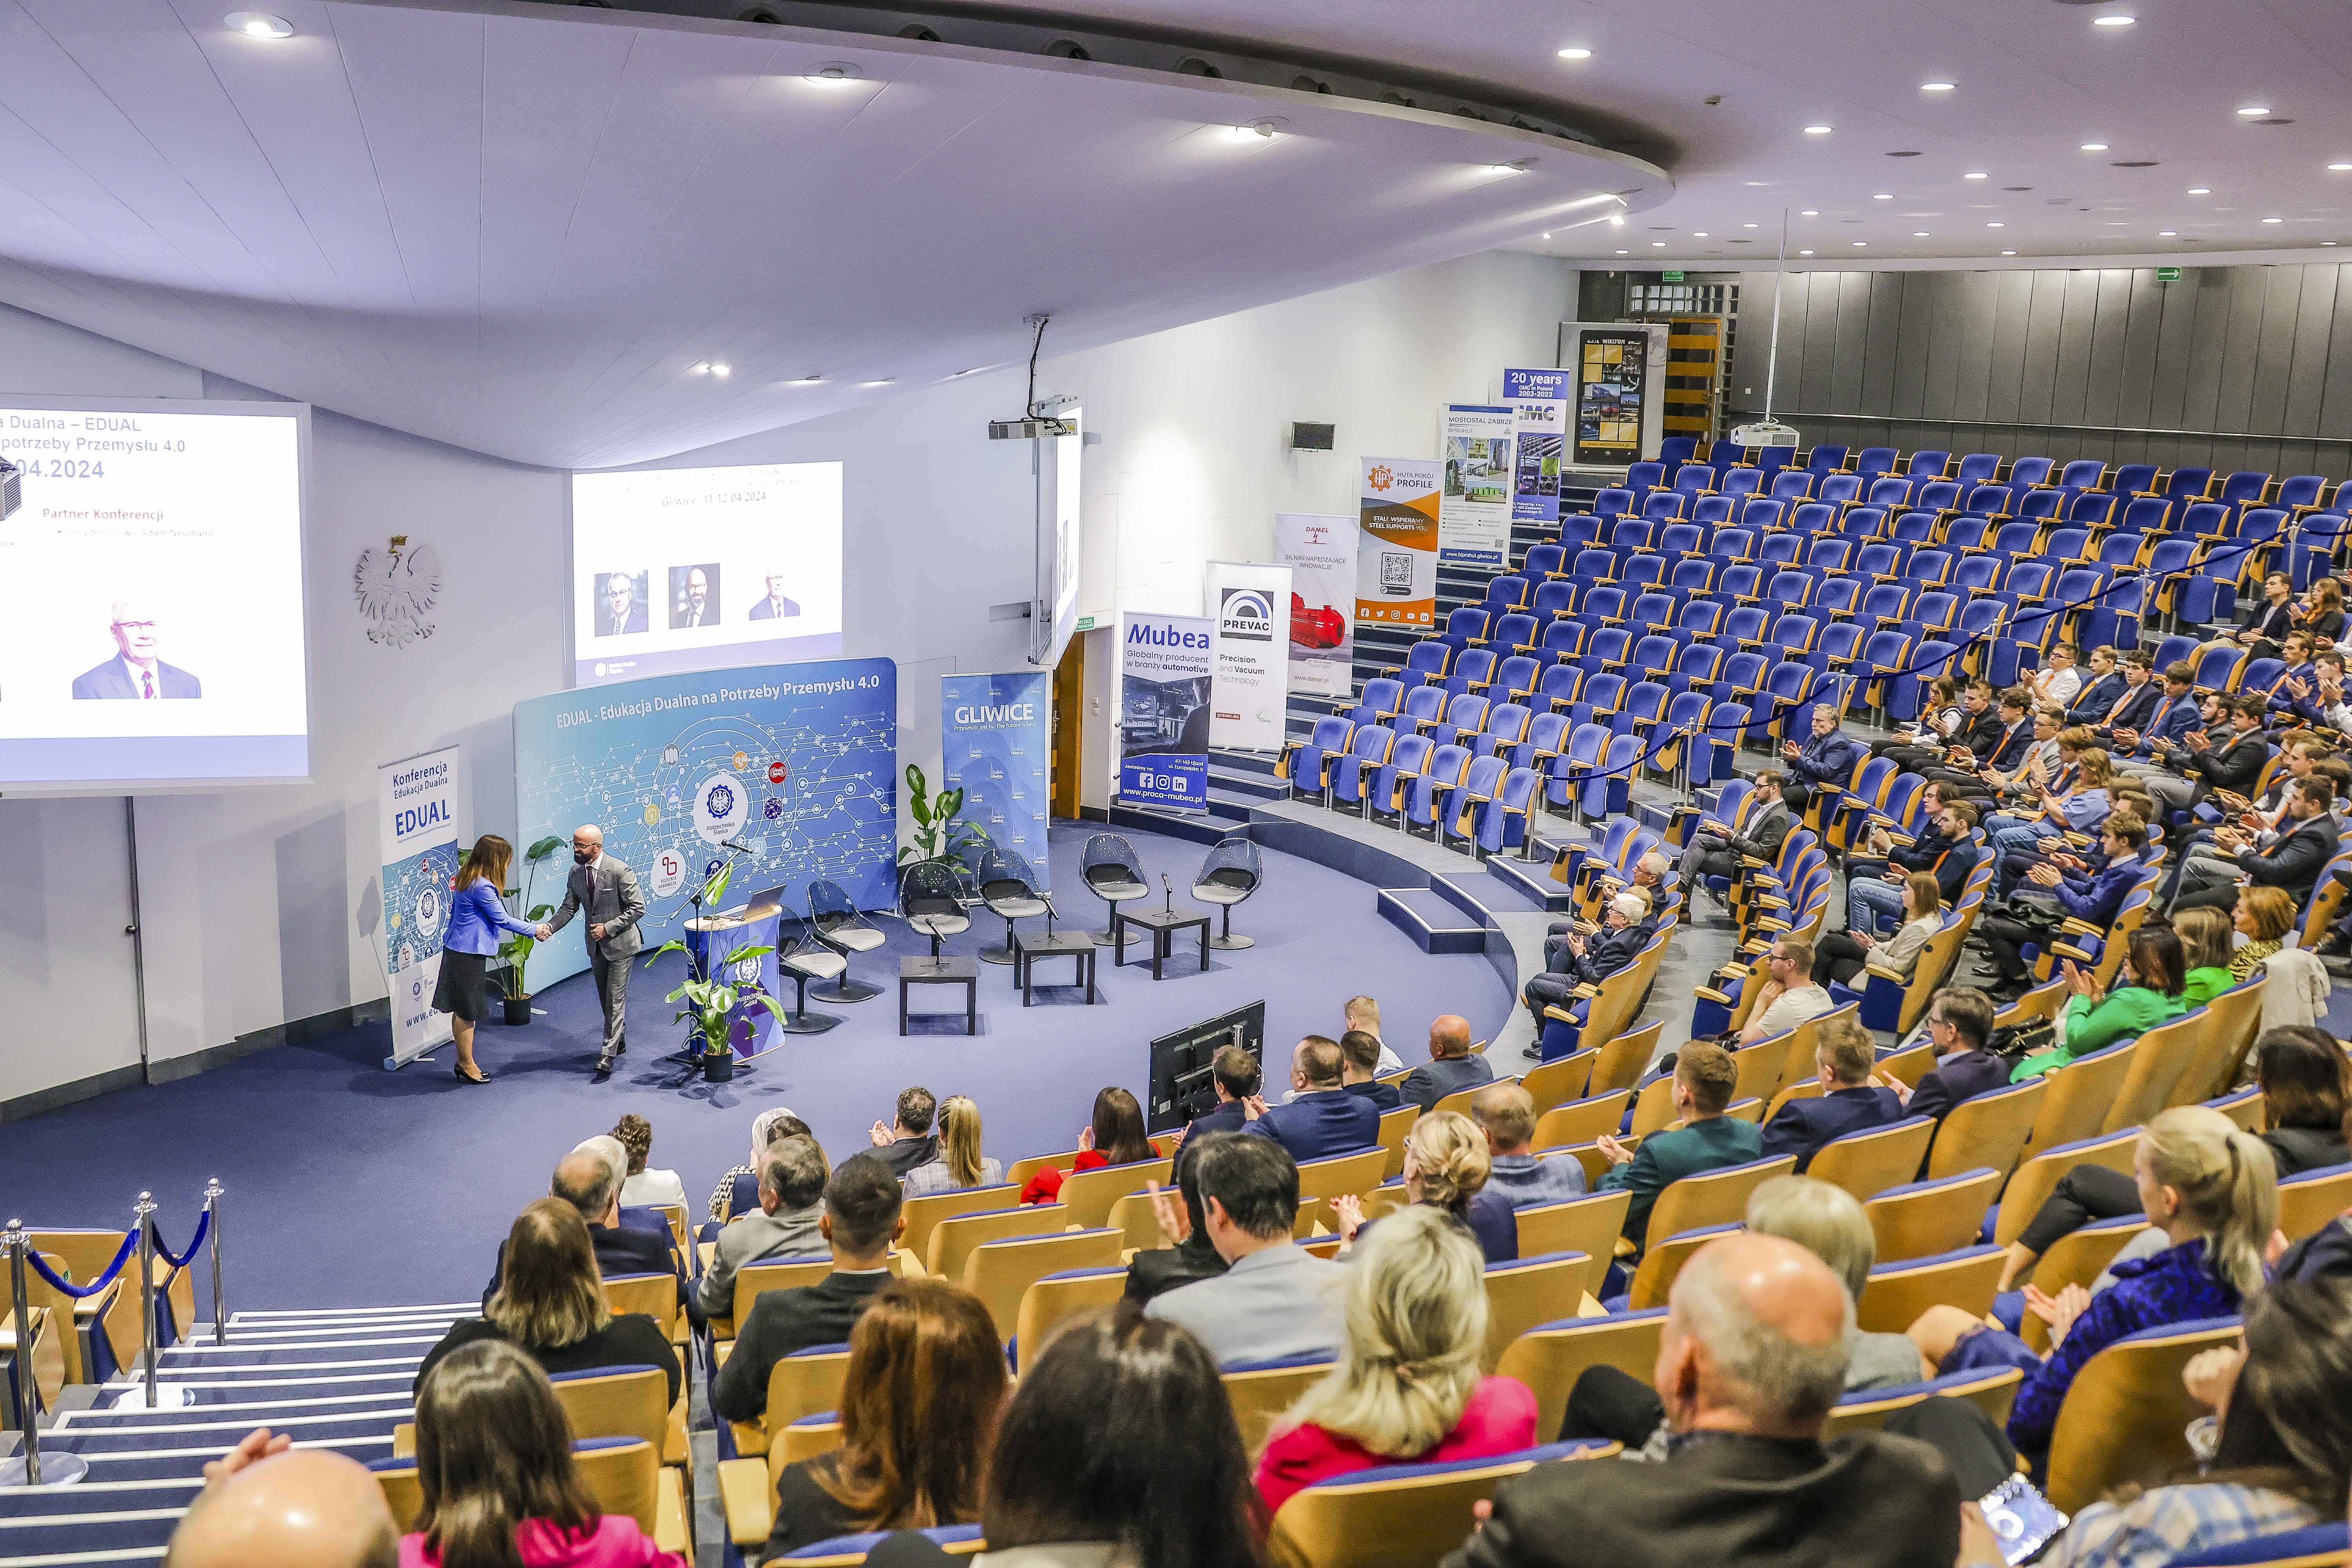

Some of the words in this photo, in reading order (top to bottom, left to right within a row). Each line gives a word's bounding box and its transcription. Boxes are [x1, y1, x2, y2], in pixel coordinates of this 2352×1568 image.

[1511, 372, 1526, 383] 20
[1530, 375, 1562, 386] years
[10, 416, 65, 430] Dualna
[85, 418, 141, 431] EDUAL
[2, 437, 70, 452] potrzeby
[77, 437, 158, 454] Przemysłu
[163, 440, 185, 452] 4.0
[1397, 479, 1433, 488] PROFILE
[43, 508, 89, 518] Partner
[94, 509, 163, 522] Konferencji
[1306, 556, 1347, 564] NAPĘDZAJĄCE
[1223, 620, 1270, 631] PREVAC
[1128, 624, 1209, 649] Mubea
[1127, 650, 1163, 661] Globalny
[1166, 654, 1209, 663] producent
[1220, 654, 1256, 663] Precision
[1135, 660, 1161, 671] branży
[1162, 664, 1209, 673] automotive
[1234, 666, 1265, 675] Vacuum
[1219, 675, 1259, 686] Technology
[556, 709, 593, 728] EDUAL
[600, 699, 653, 720] Edukacja
[654, 693, 699, 711] Dualna
[702, 692, 718, 704] na
[720, 683, 780, 702] Potrzeby
[783, 677, 855, 696] Przemysłu
[857, 675, 880, 689] 4.0
[954, 703, 1034, 724] GLIWICE
[393, 761, 447, 788] Konferencja
[394, 782, 423, 799] Edukacja
[425, 776, 448, 789] Dualna
[1123, 788, 1203, 804] www.praca-mubea.pl
[396, 799, 450, 836] EDUAL
[706, 822, 735, 831] Politechnika
[736, 991, 763, 1004] Politechnika
[406, 1008, 438, 1027] www.ed
